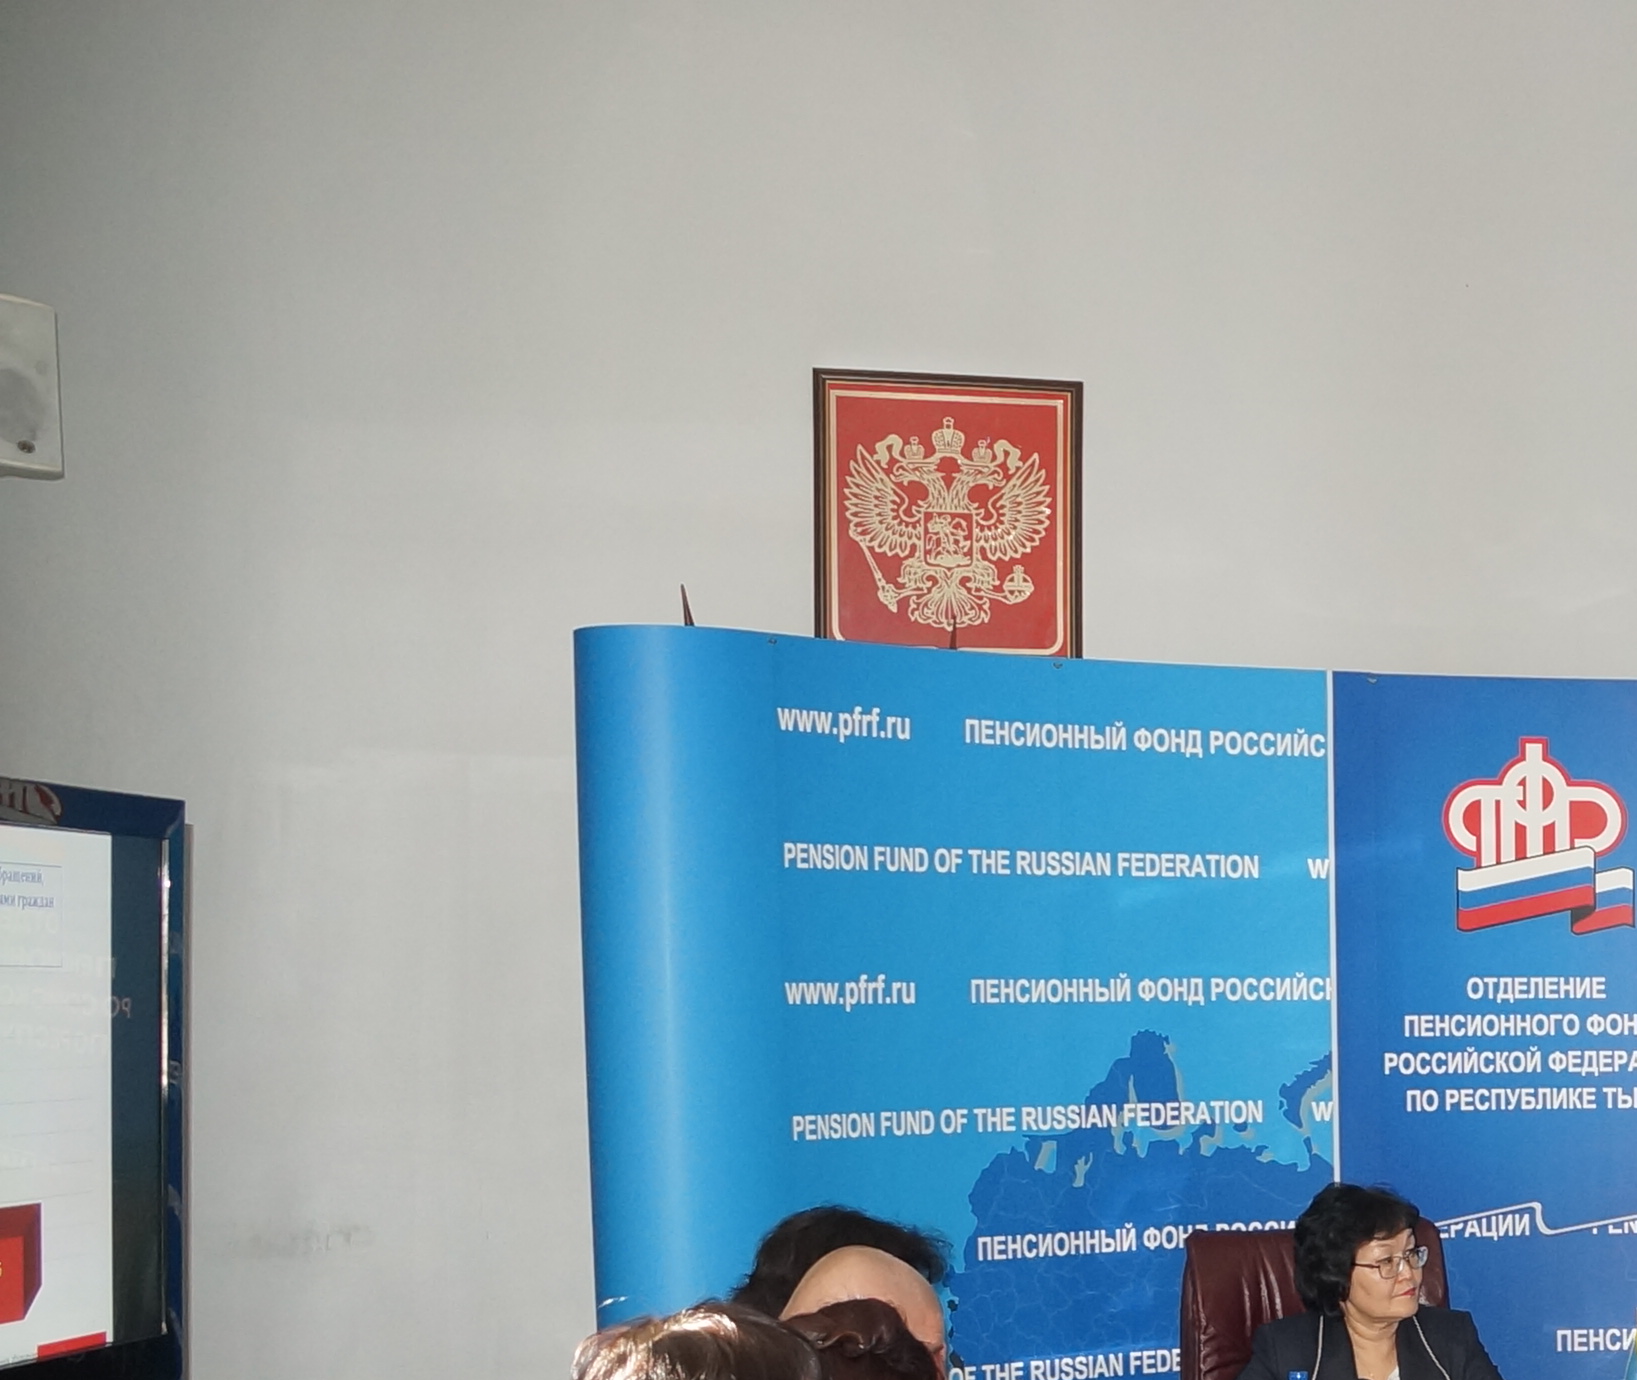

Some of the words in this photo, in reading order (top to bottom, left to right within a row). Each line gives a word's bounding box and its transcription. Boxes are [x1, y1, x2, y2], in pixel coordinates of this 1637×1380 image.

[777, 705, 911, 743] www.pfrf.ru
[965, 718, 1127, 751] ПЕНСИОННЫЙ
[1133, 727, 1203, 759] ФОНД
[783, 842, 869, 871] PENSION
[873, 846, 929, 873] FUND
[933, 847, 963, 874] OF
[967, 849, 1011, 875] THE
[1016, 850, 1112, 877] RUSSIAN
[1117, 852, 1260, 879] FEDERATION
[784, 973, 916, 1012] www.pfrf.ru
[970, 972, 1132, 1004] ПЕНСИОННЫЙ
[1137, 977, 1205, 1006] ФОНД
[1466, 976, 1607, 1004] ОТДЕЛЕНИЕ
[1404, 1013, 1581, 1037] ПЕНСИОННОГО
[1384, 1045, 1542, 1075] РОССИЙСКОЙ
[1406, 1089, 1439, 1112] ПО
[1445, 1087, 1597, 1111] РЕСПУБЛИКЕ
[792, 1112, 875, 1141] PENSION
[880, 1109, 935, 1137] FUND
[939, 1108, 969, 1134] OF
[973, 1107, 1016, 1133] THE
[1021, 1103, 1118, 1131] RUSSIAN
[1122, 1099, 1263, 1127] FEDERATION
[977, 1222, 1137, 1261] ПЕНСИОННЫЙ
[1142, 1224, 1200, 1250] ФОН
